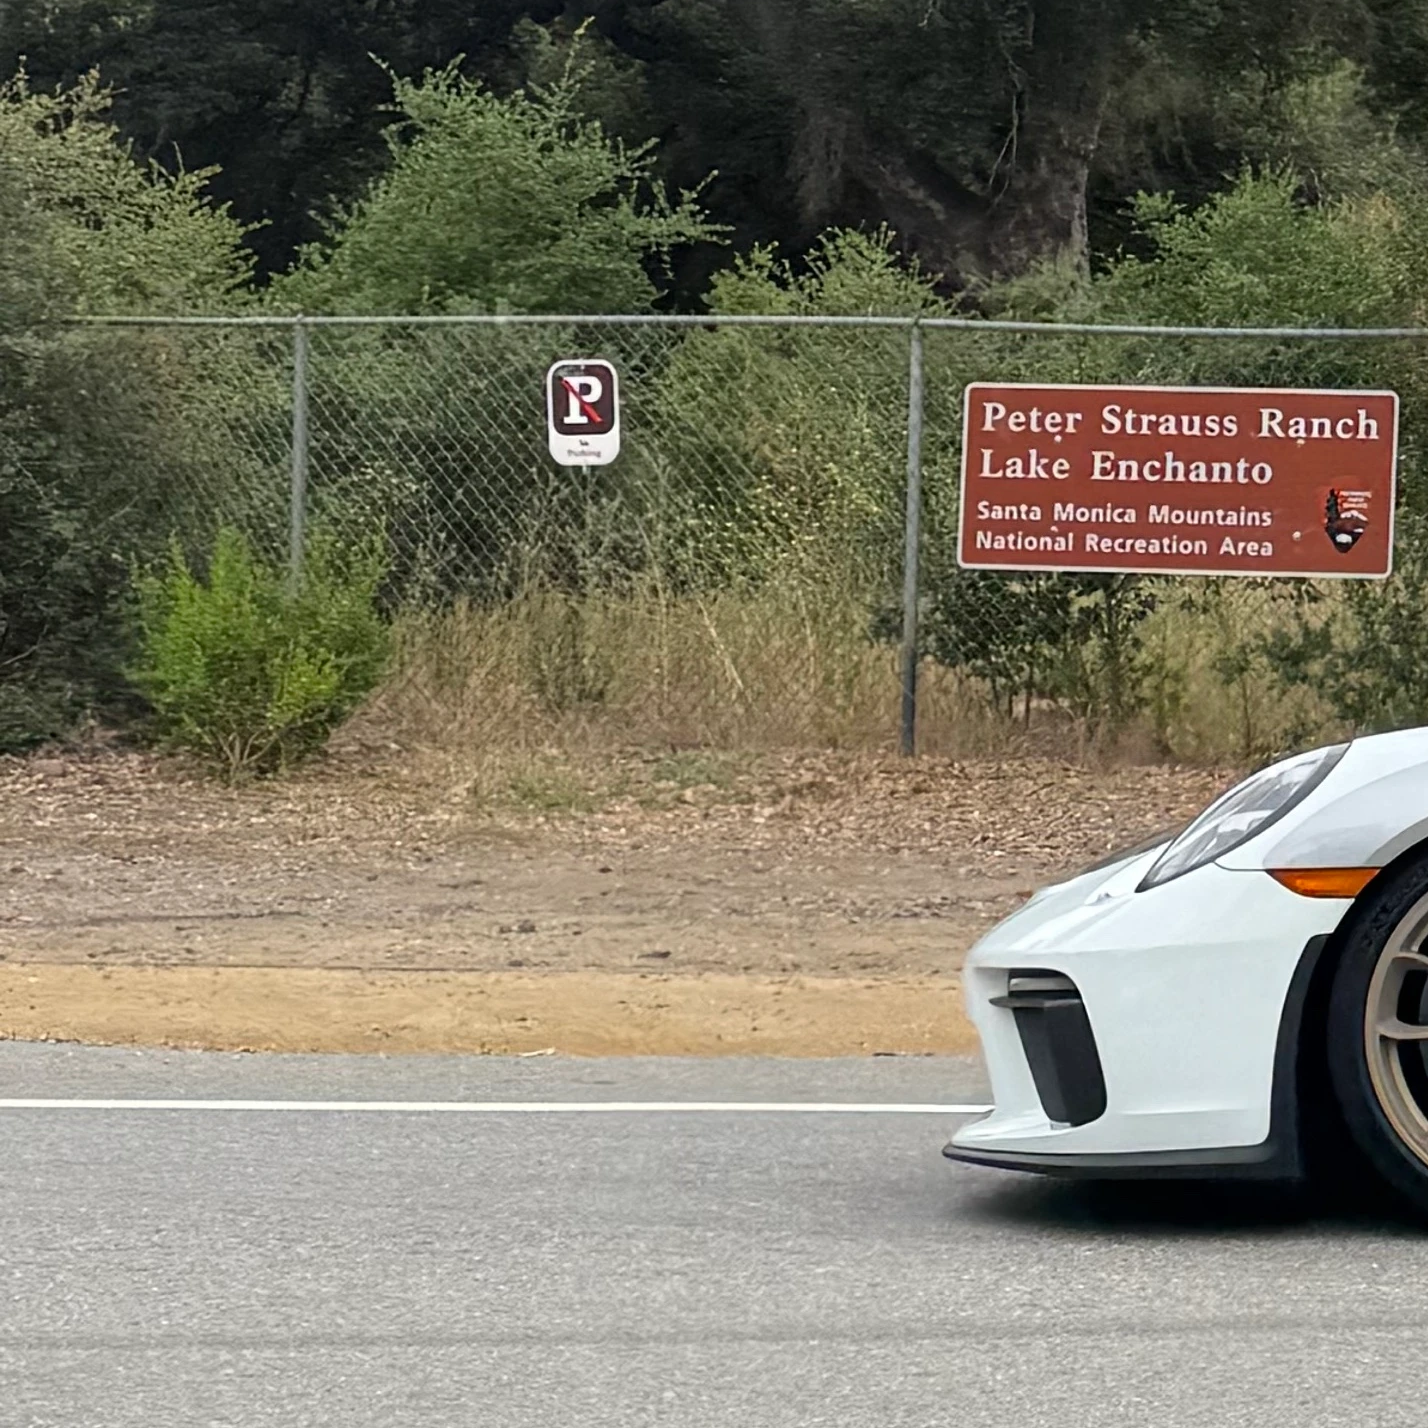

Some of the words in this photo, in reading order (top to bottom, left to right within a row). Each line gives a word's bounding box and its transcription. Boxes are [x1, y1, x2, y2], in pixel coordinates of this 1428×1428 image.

[981, 402, 1083, 433] Peter
[1101, 404, 1238, 437] Strauss
[1258, 408, 1379, 439] Ranch
[979, 448, 1071, 479] Lake
[1090, 450, 1273, 484] Enchanto
[977, 500, 1042, 521] Santa
[1053, 502, 1137, 523] Monica
[1148, 505, 1273, 527] Mountains
[976, 531, 1074, 552] National
[1085, 533, 1208, 555] Recreation
[1219, 536, 1273, 557] Area
